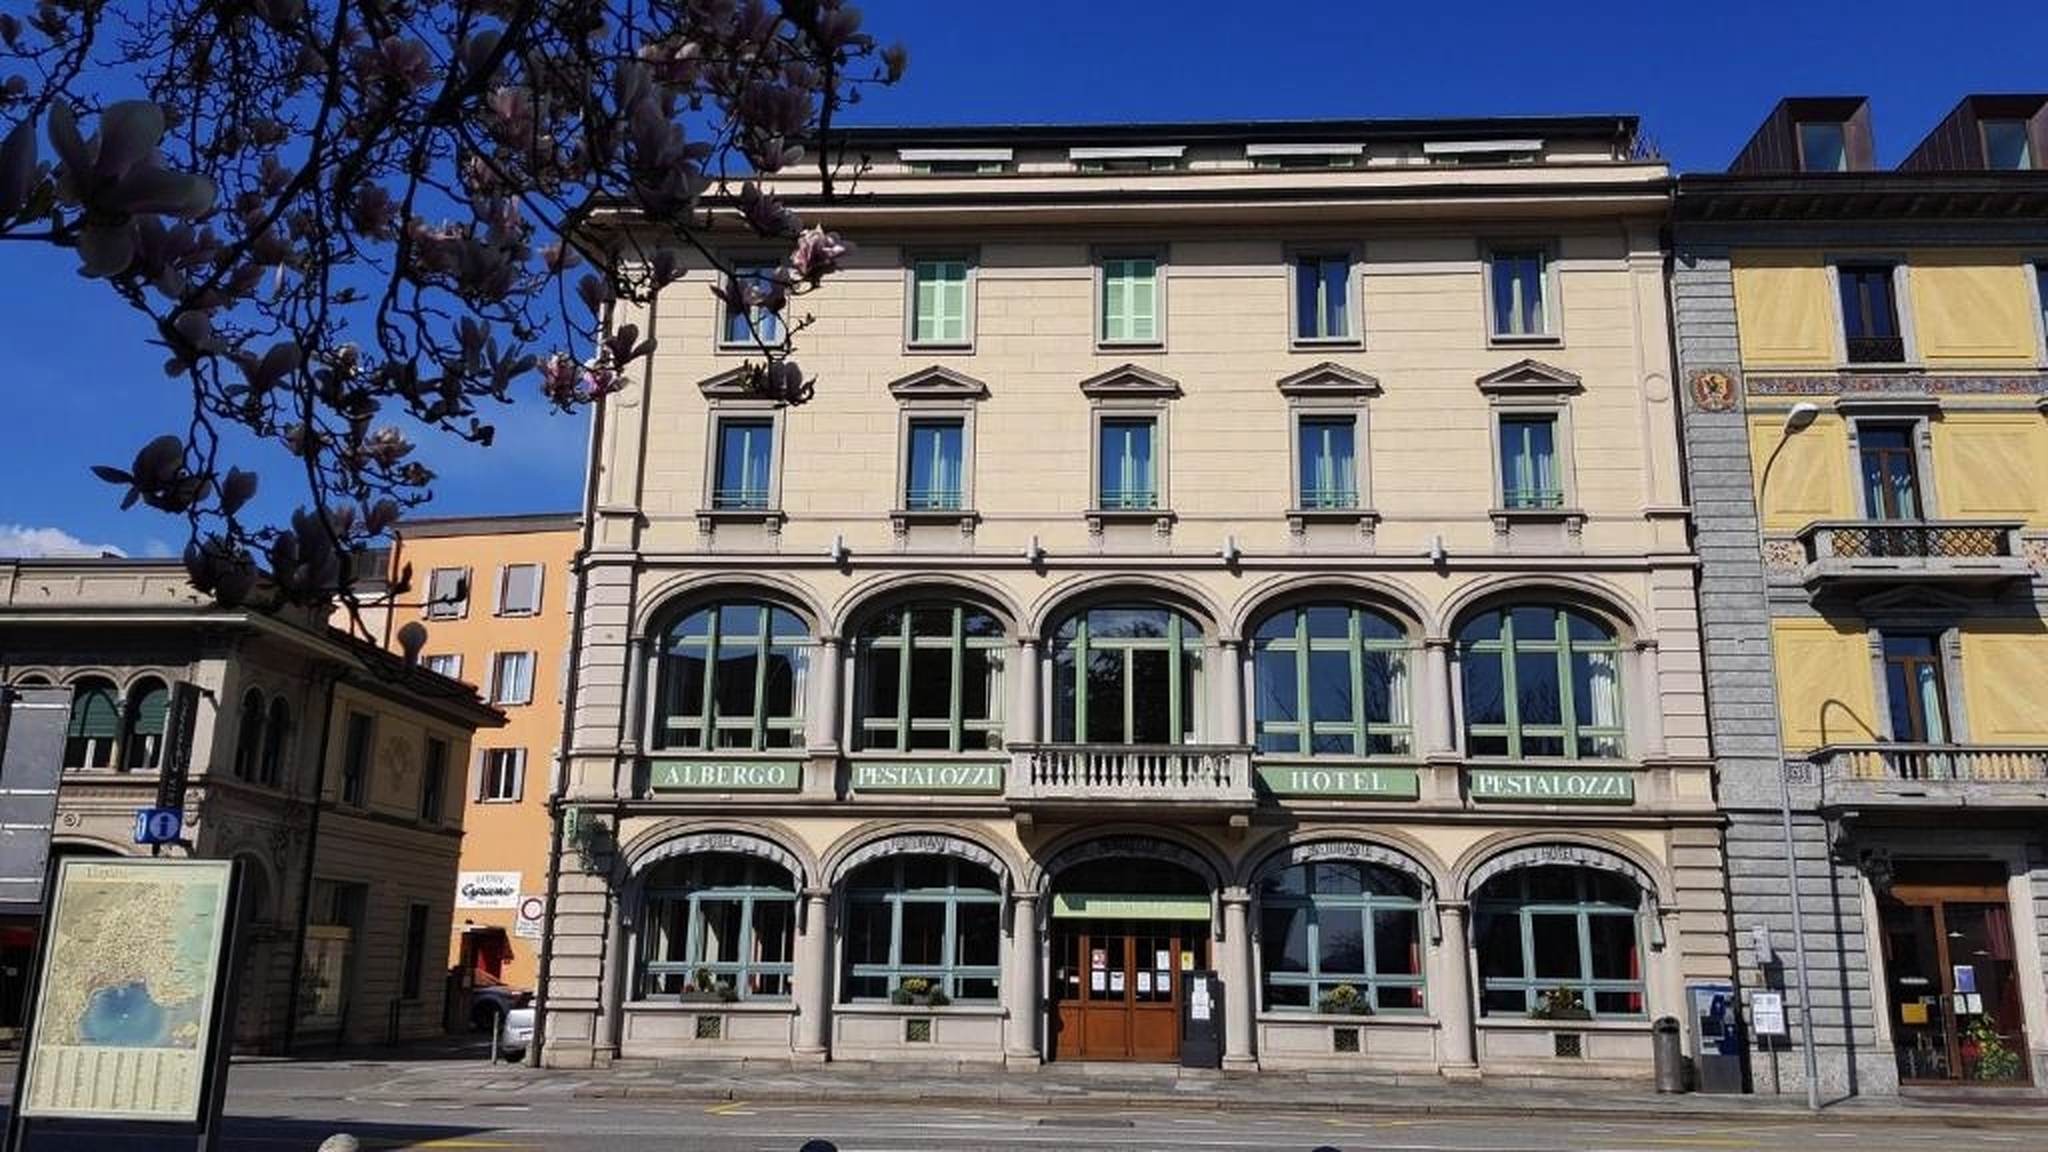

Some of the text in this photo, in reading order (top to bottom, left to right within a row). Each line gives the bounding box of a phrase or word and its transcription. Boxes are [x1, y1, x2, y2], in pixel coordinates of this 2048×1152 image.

[666, 766, 785, 785] ALBERGO
[858, 767, 994, 786] PESTALOZZI
[1291, 772, 1387, 791] HOTEL
[1479, 775, 1626, 795] PESTALOZZI
